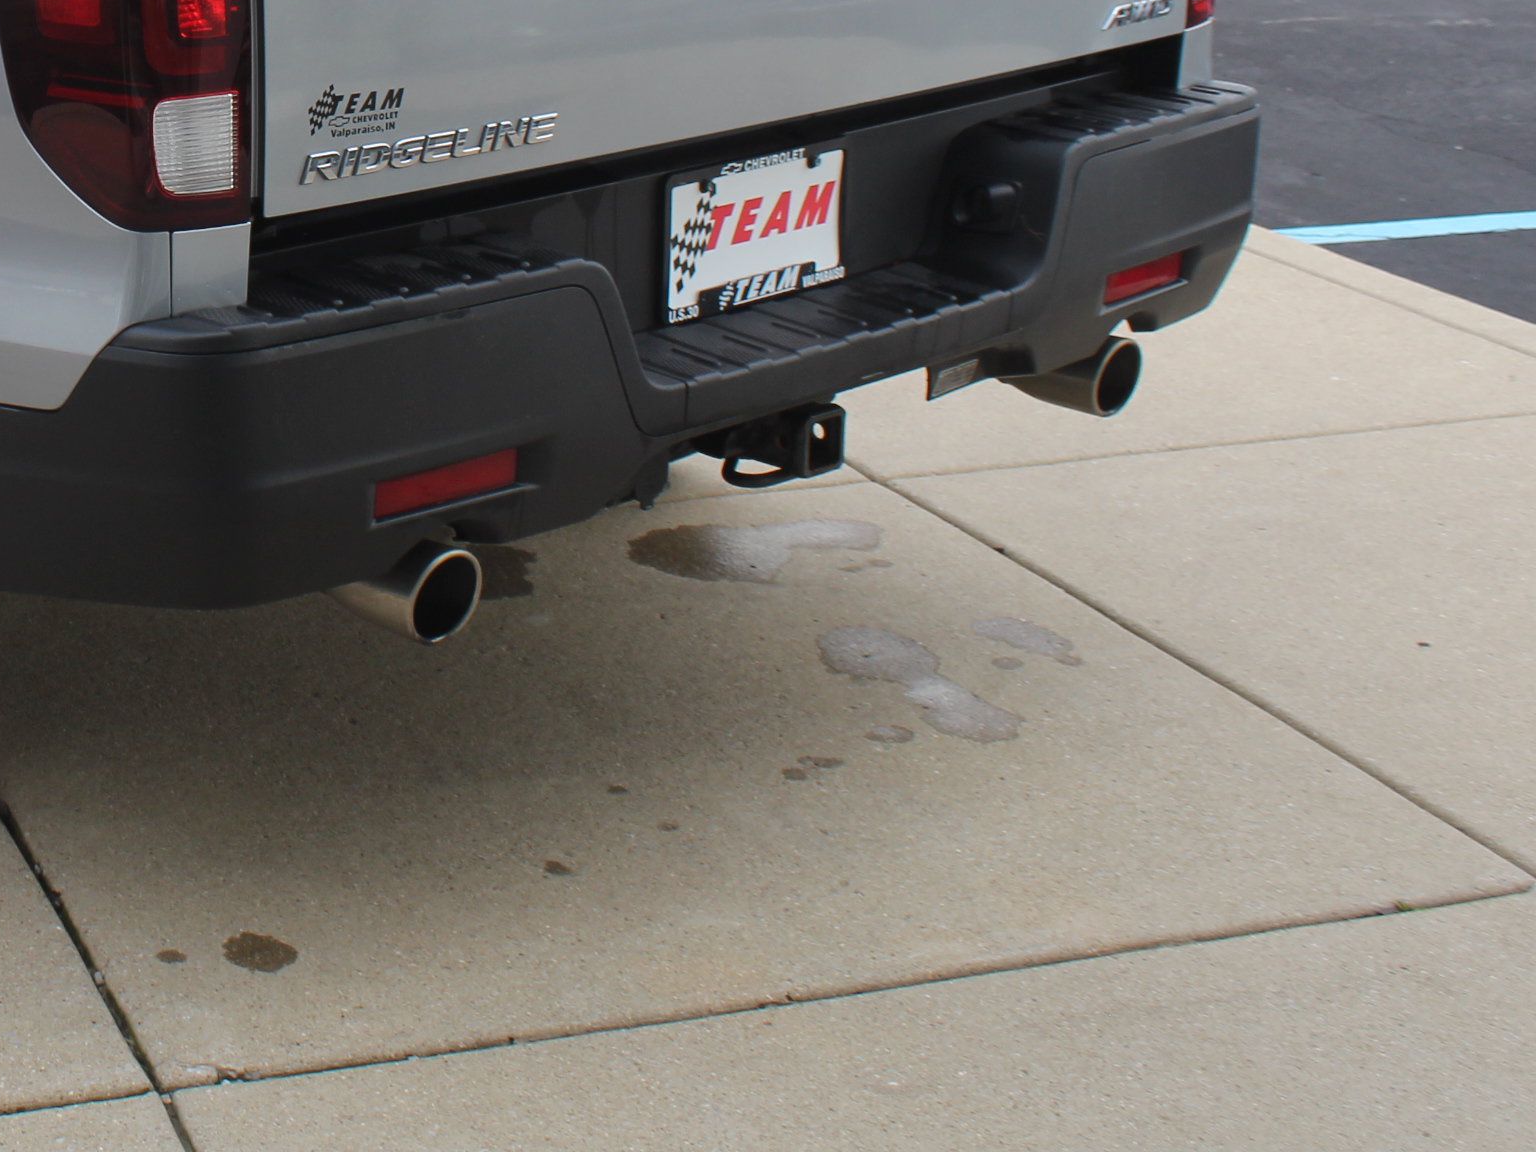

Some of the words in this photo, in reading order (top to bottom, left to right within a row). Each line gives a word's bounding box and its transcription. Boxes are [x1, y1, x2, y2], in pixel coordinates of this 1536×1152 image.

[328, 87, 405, 116] TEAM
[331, 124, 384, 138] Valparaiso,
[385, 121, 396, 132] IN
[352, 111, 399, 124] CHEVROLET
[298, 112, 559, 185] RIDGELINE
[743, 147, 806, 172] CHEVROLET
[704, 180, 837, 252] TEAM
[732, 264, 801, 303] TEAM
